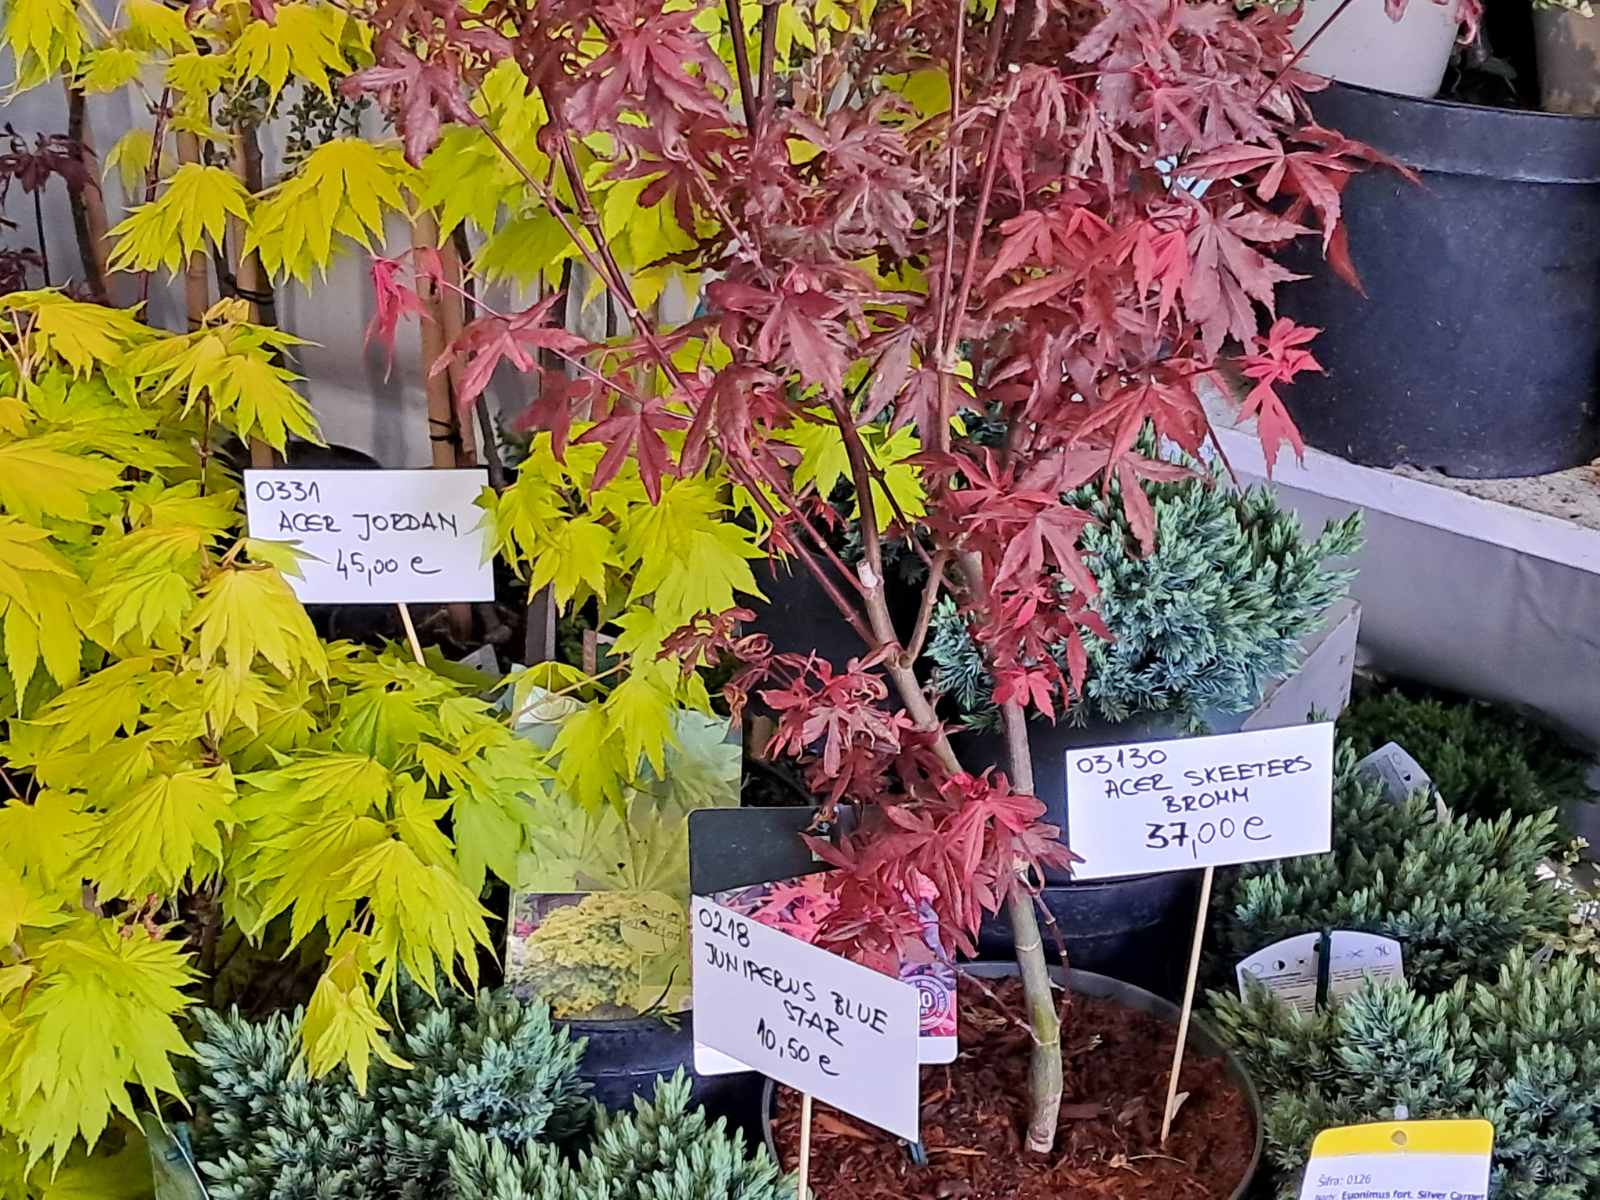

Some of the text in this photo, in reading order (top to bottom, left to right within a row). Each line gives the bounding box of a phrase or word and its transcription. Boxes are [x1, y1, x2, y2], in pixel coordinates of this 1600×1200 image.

[255, 480, 320, 503] 0331
[279, 510, 458, 541] ACER JORDAN
[336, 548, 399, 587] 45,00
[1076, 748, 1168, 775] 03130
[1104, 755, 1313, 800] ACER SKEETERS
[699, 908, 750, 948] 0218
[704, 942, 889, 1035] JUNIPERUS BLUE
[756, 1017, 810, 1063] 10,50
[783, 999, 844, 1047] STAR
[1346, 1174, 1371, 1186] 0126
